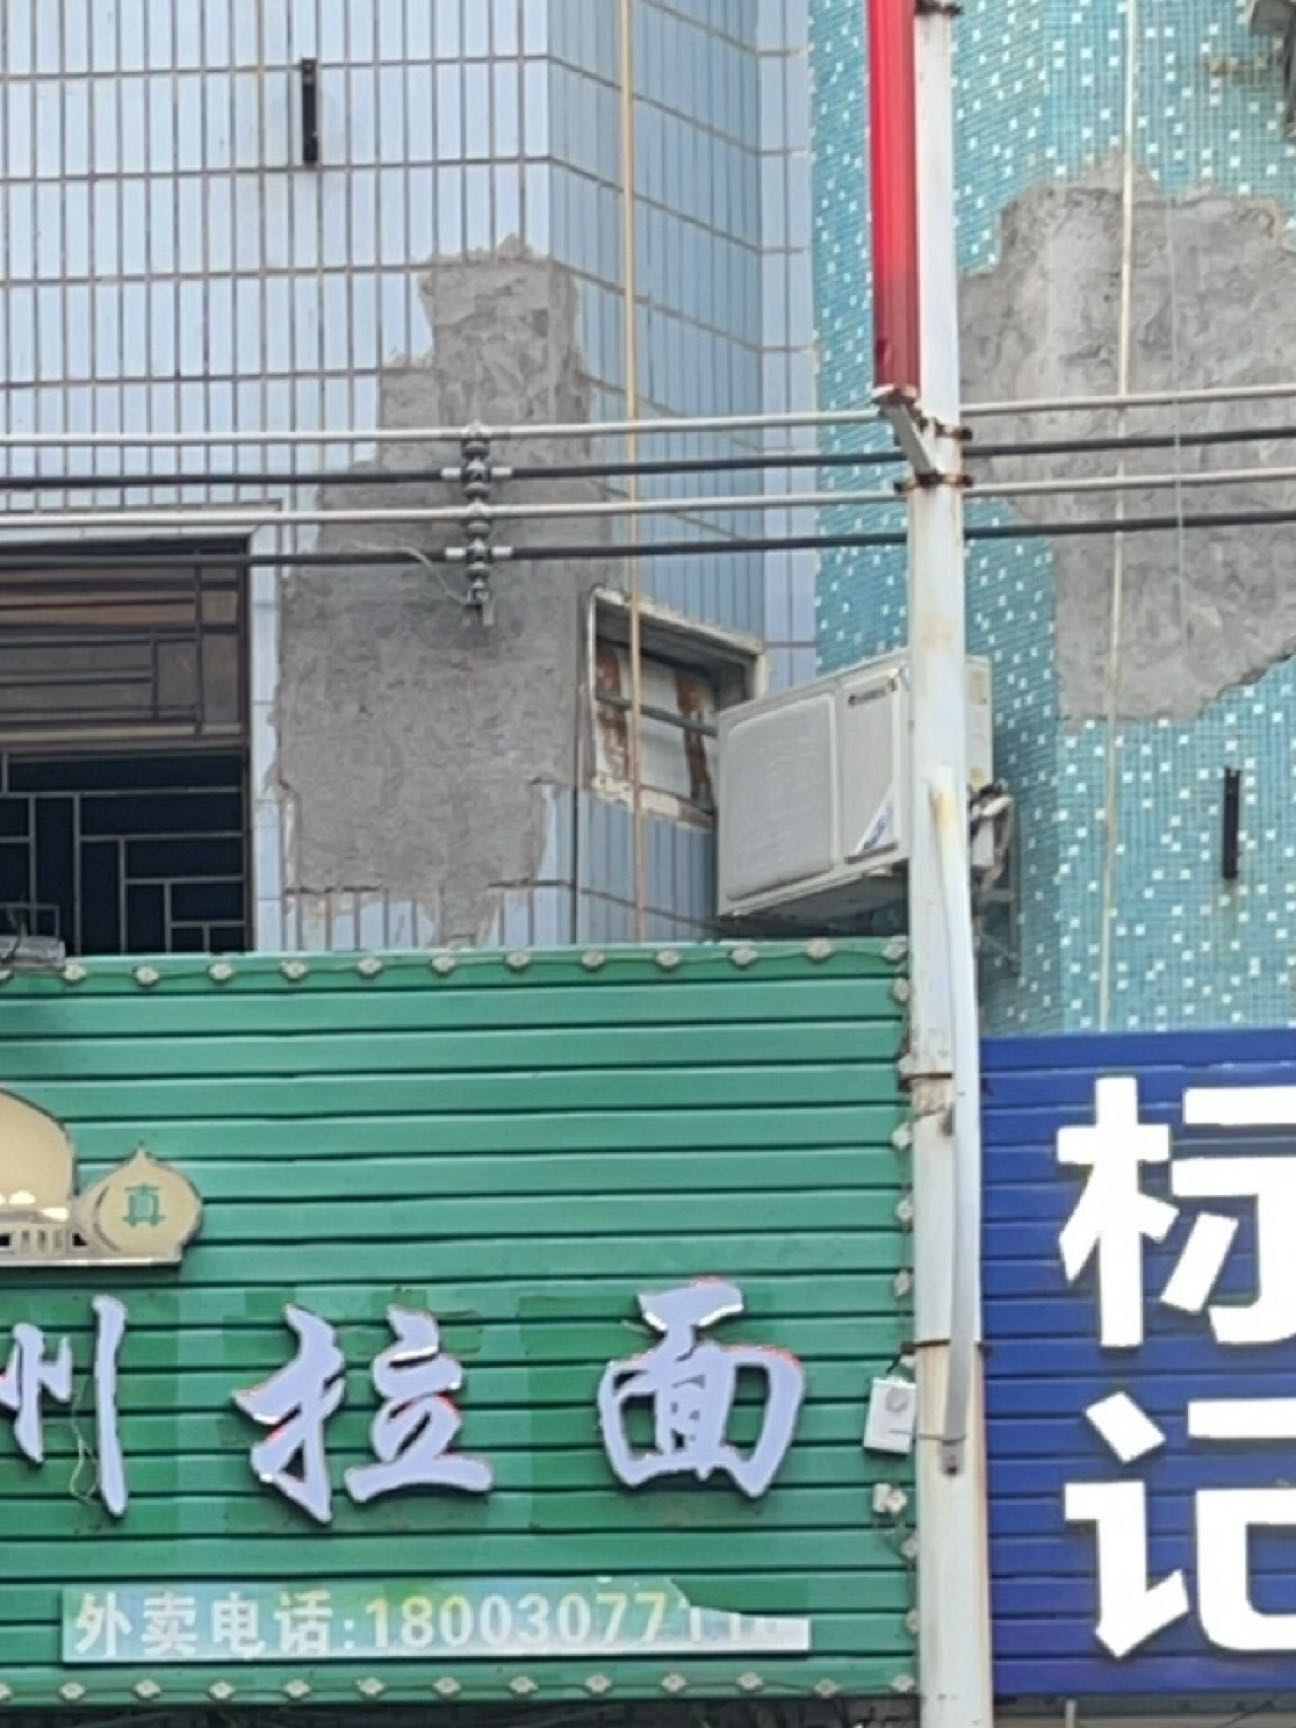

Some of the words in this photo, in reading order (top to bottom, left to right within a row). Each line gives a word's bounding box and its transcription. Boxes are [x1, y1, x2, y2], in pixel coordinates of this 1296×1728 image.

[123, 1184, 165, 1227] 真
[1056, 1076, 1296, 1347] 标
[1064, 1392, 1296, 1658] 记
